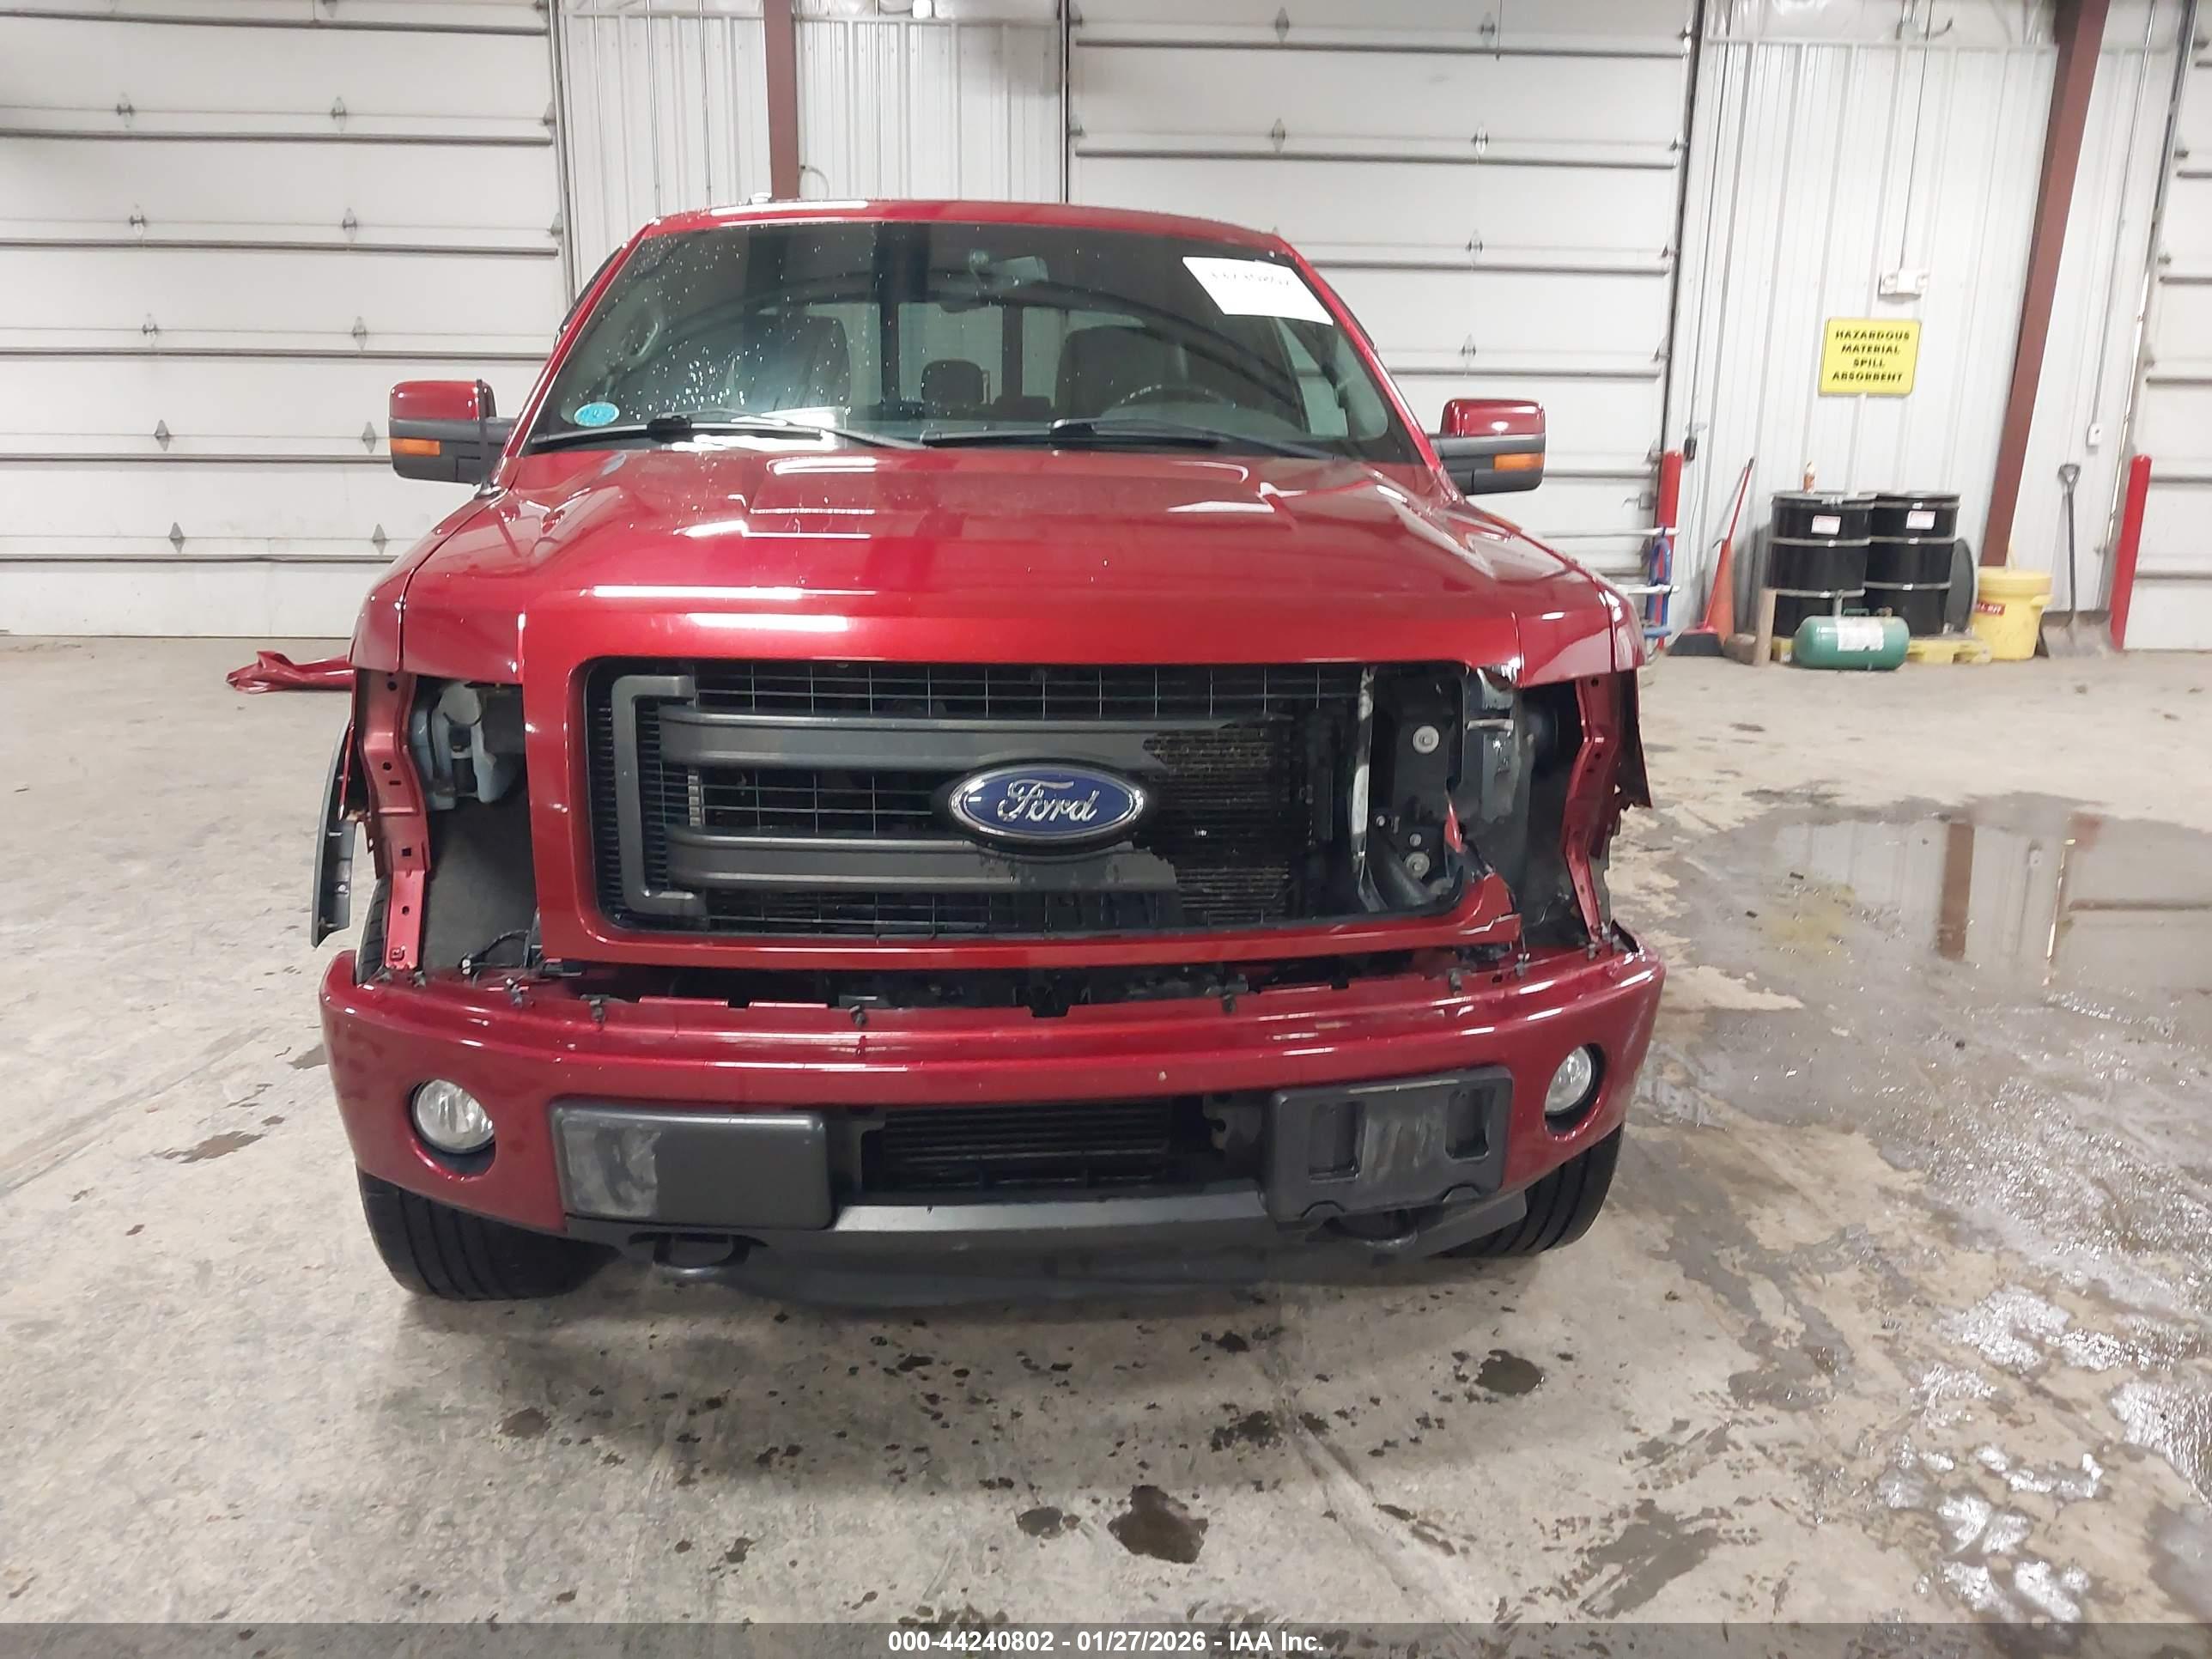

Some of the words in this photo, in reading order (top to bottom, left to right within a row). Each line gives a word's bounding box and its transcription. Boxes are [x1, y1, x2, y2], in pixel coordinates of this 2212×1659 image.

[1835, 330, 1910, 341] HAZARDOUS
[1841, 343, 1900, 355] MATERIAL
[1853, 358, 1885, 368] SPILL
[1832, 372, 1903, 382] ABSORBENT
[997, 779, 1101, 823] Ford
